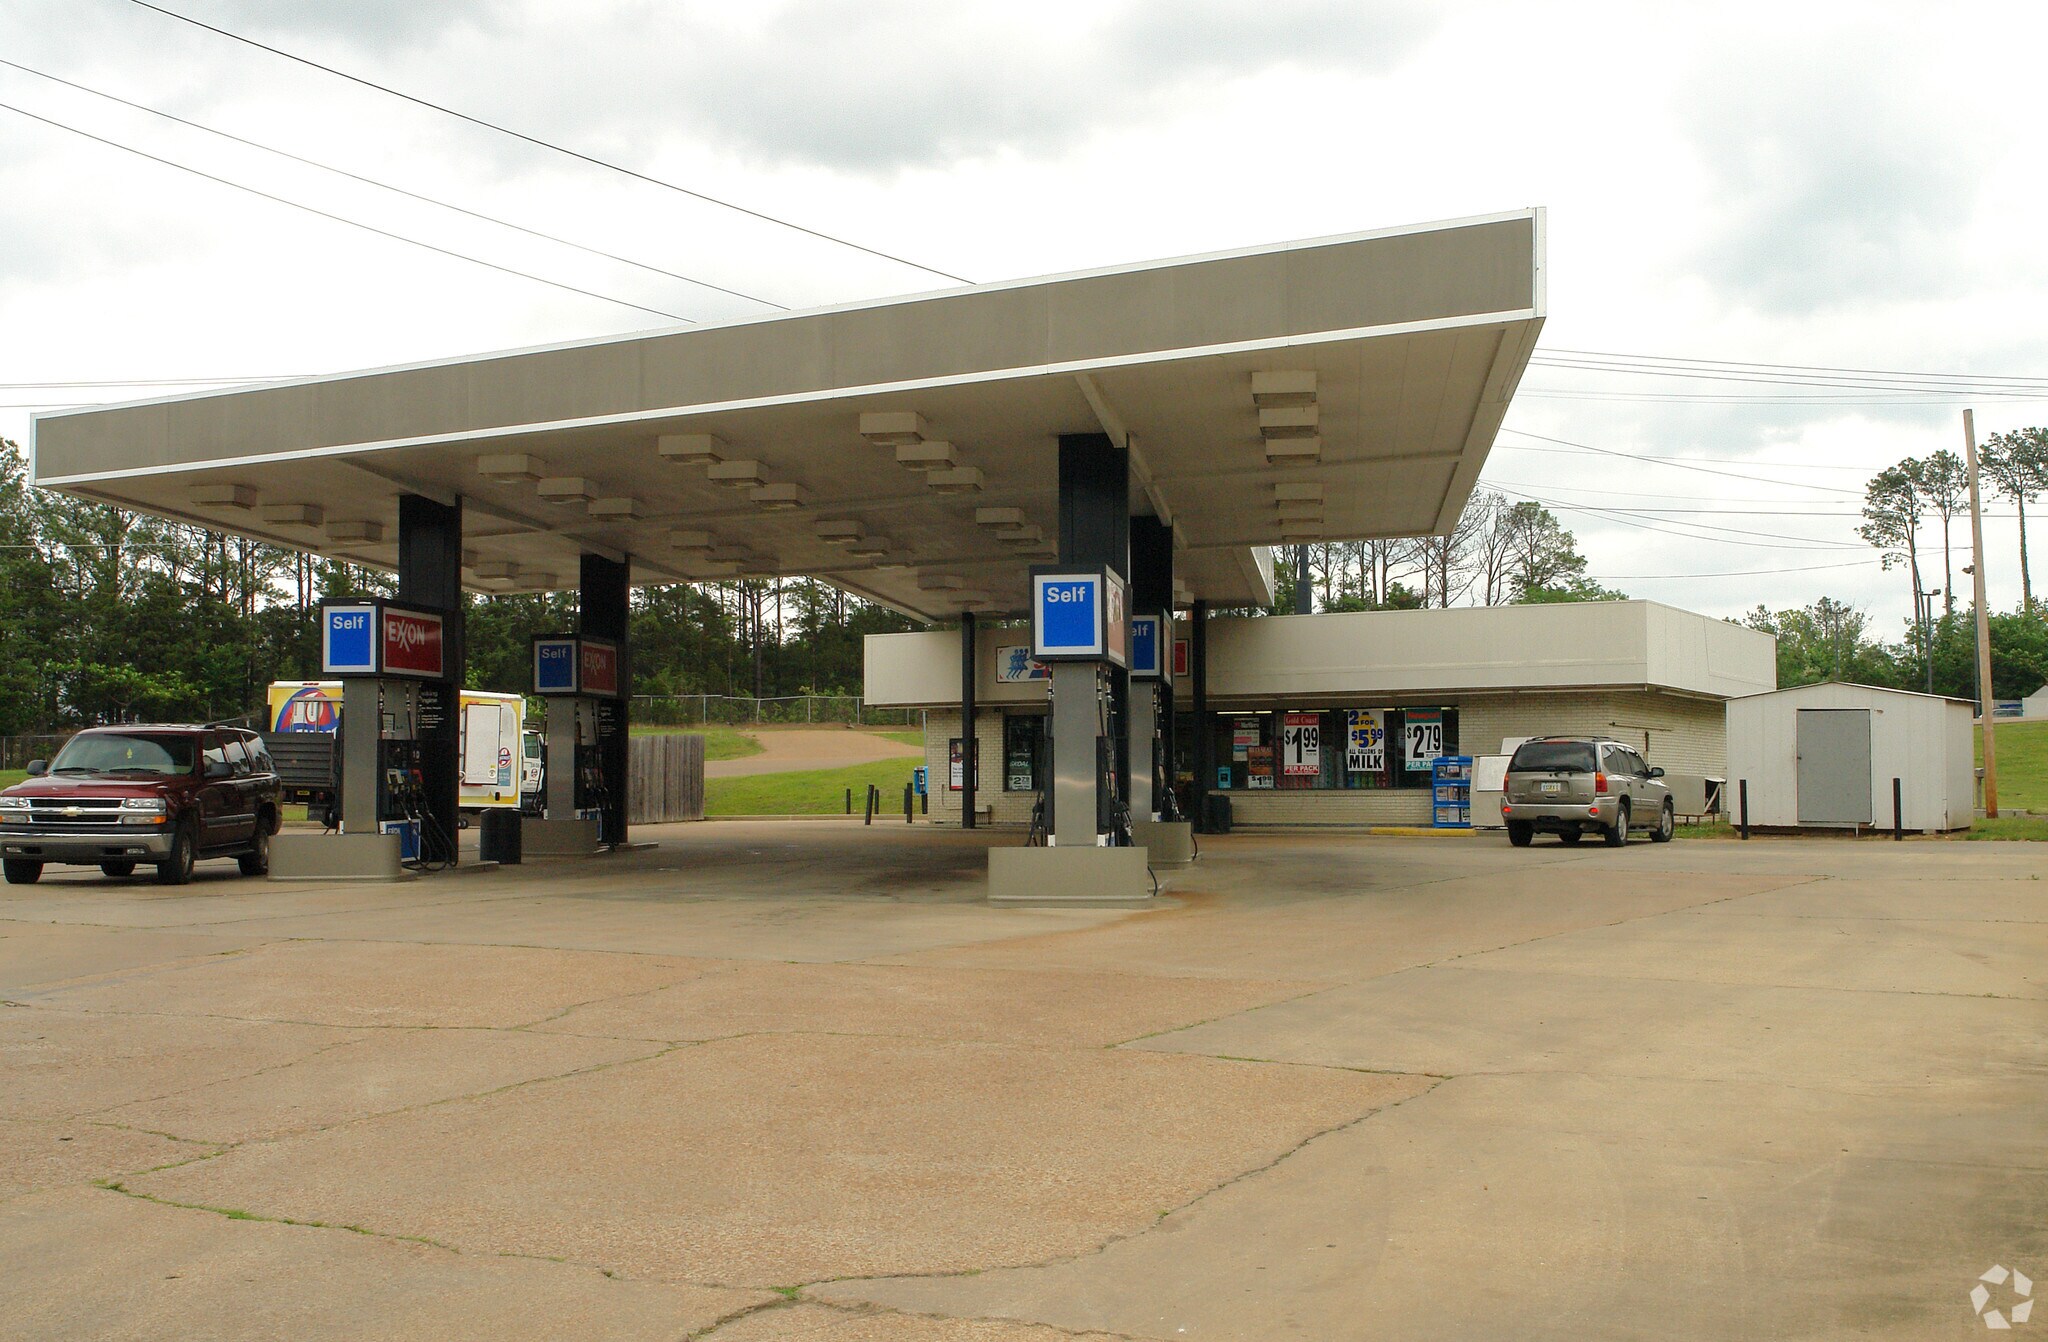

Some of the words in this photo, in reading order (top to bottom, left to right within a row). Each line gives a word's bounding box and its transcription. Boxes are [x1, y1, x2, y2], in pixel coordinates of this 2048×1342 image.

[1047, 586, 1086, 602] Self
[333, 616, 364, 630] Self
[388, 619, 425, 653] EXXON
[1132, 624, 1148, 637] elf
[542, 648, 567, 659] Self
[1285, 716, 1299, 724] Gold
[1301, 715, 1317, 724] Coast
[1349, 710, 1359, 726] 2
[1285, 765, 1299, 773] PER
[1300, 765, 1318, 773] PACK
[1349, 755, 1382, 769] MILK
